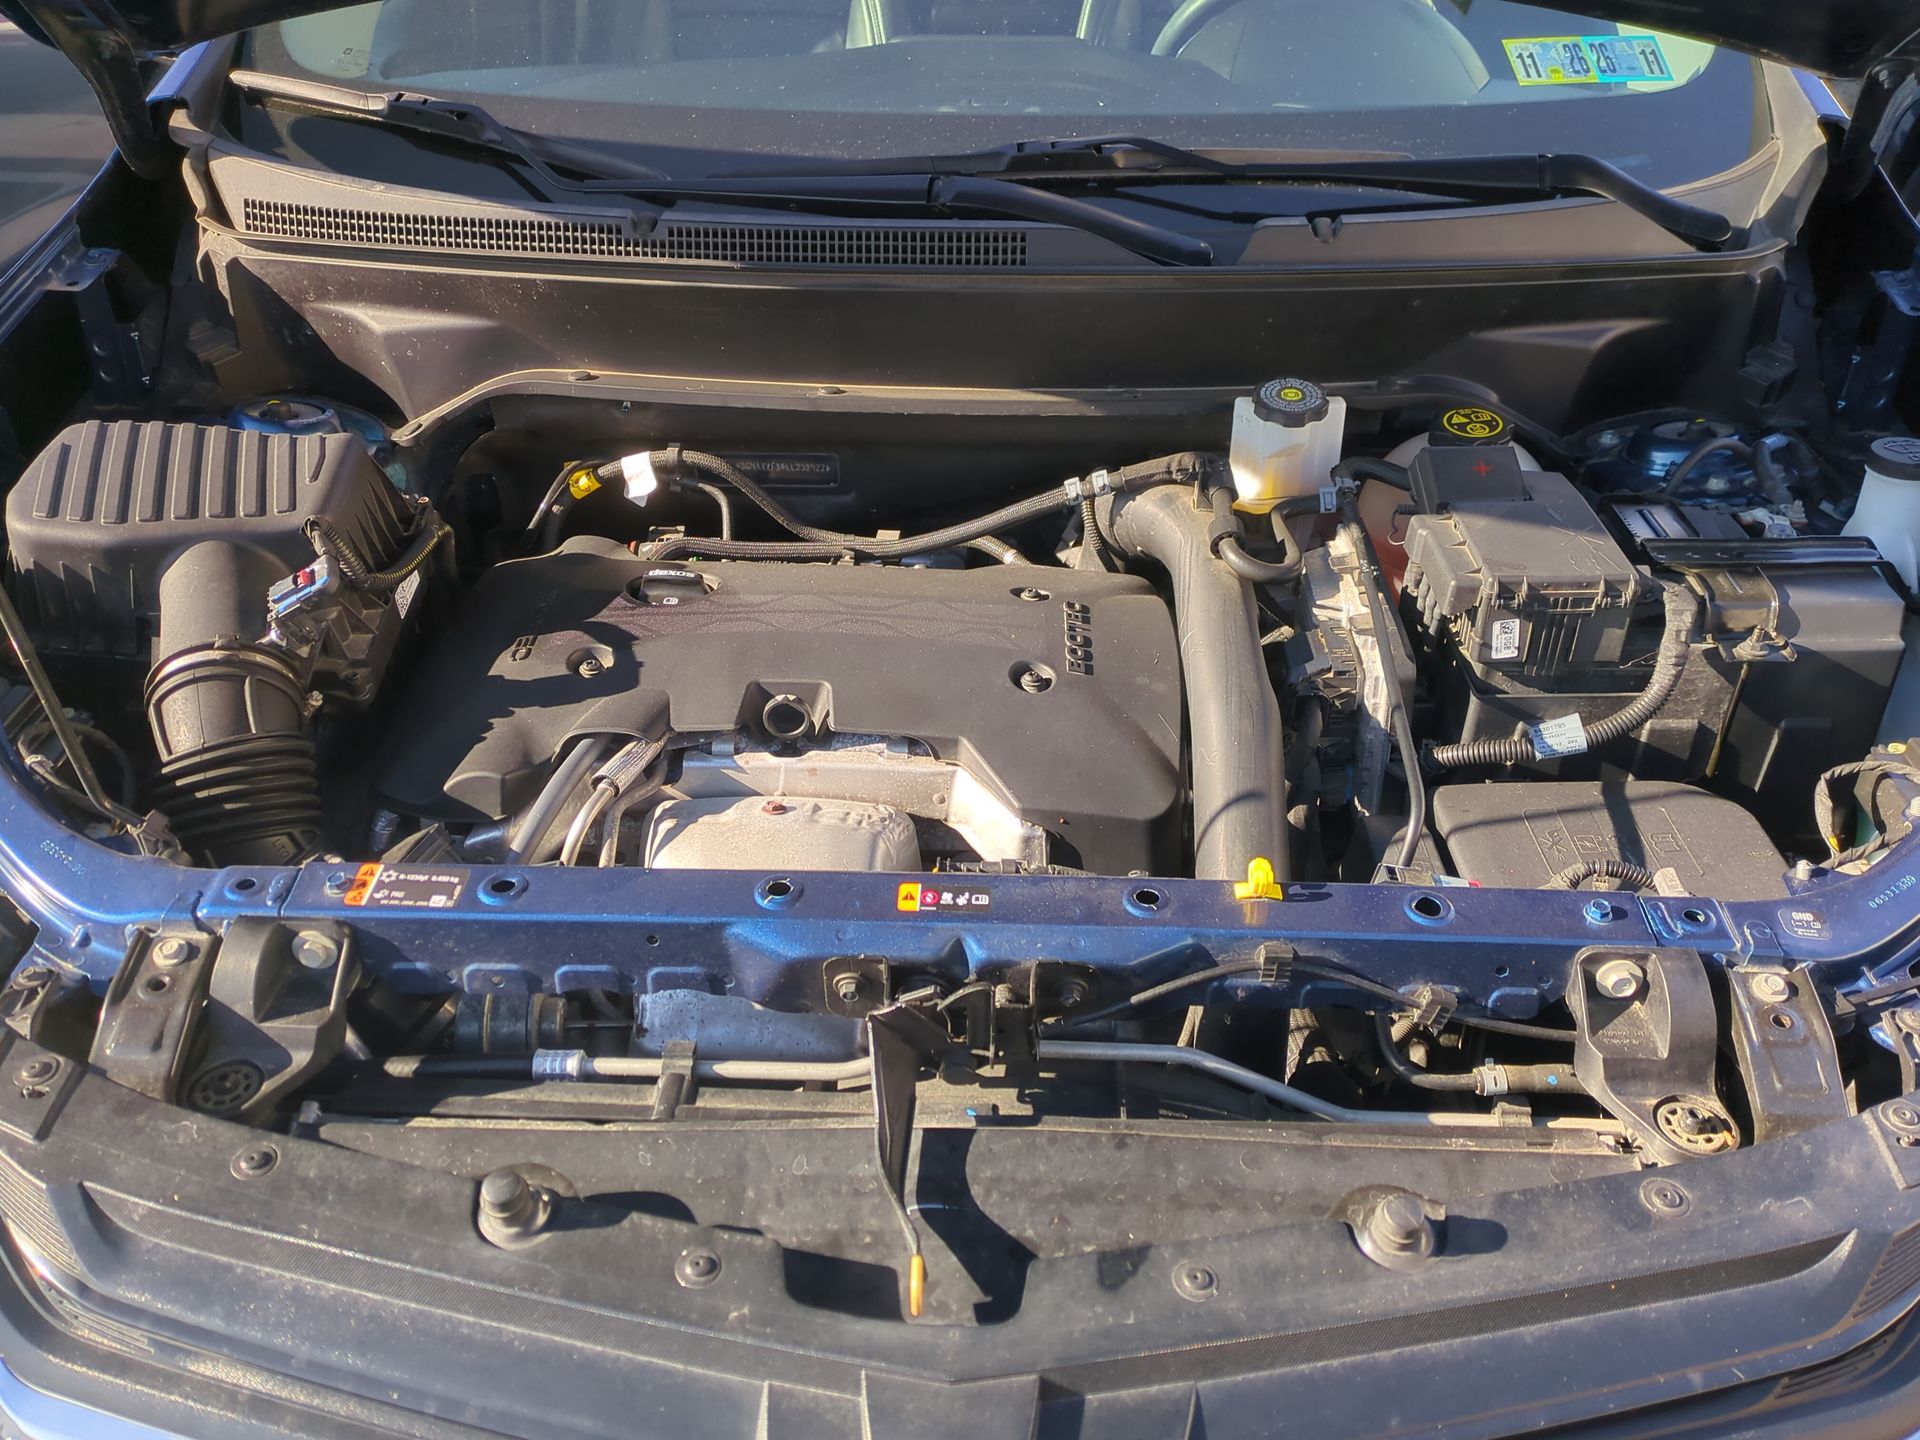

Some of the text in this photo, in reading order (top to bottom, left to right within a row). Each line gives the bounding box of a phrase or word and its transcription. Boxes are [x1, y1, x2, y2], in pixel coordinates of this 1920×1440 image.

[1515, 43, 1666, 79] 11 26 26 11
[648, 568, 696, 578] dexos
[1063, 601, 1093, 676] ECOTEC
[1791, 911, 1814, 922] GND
